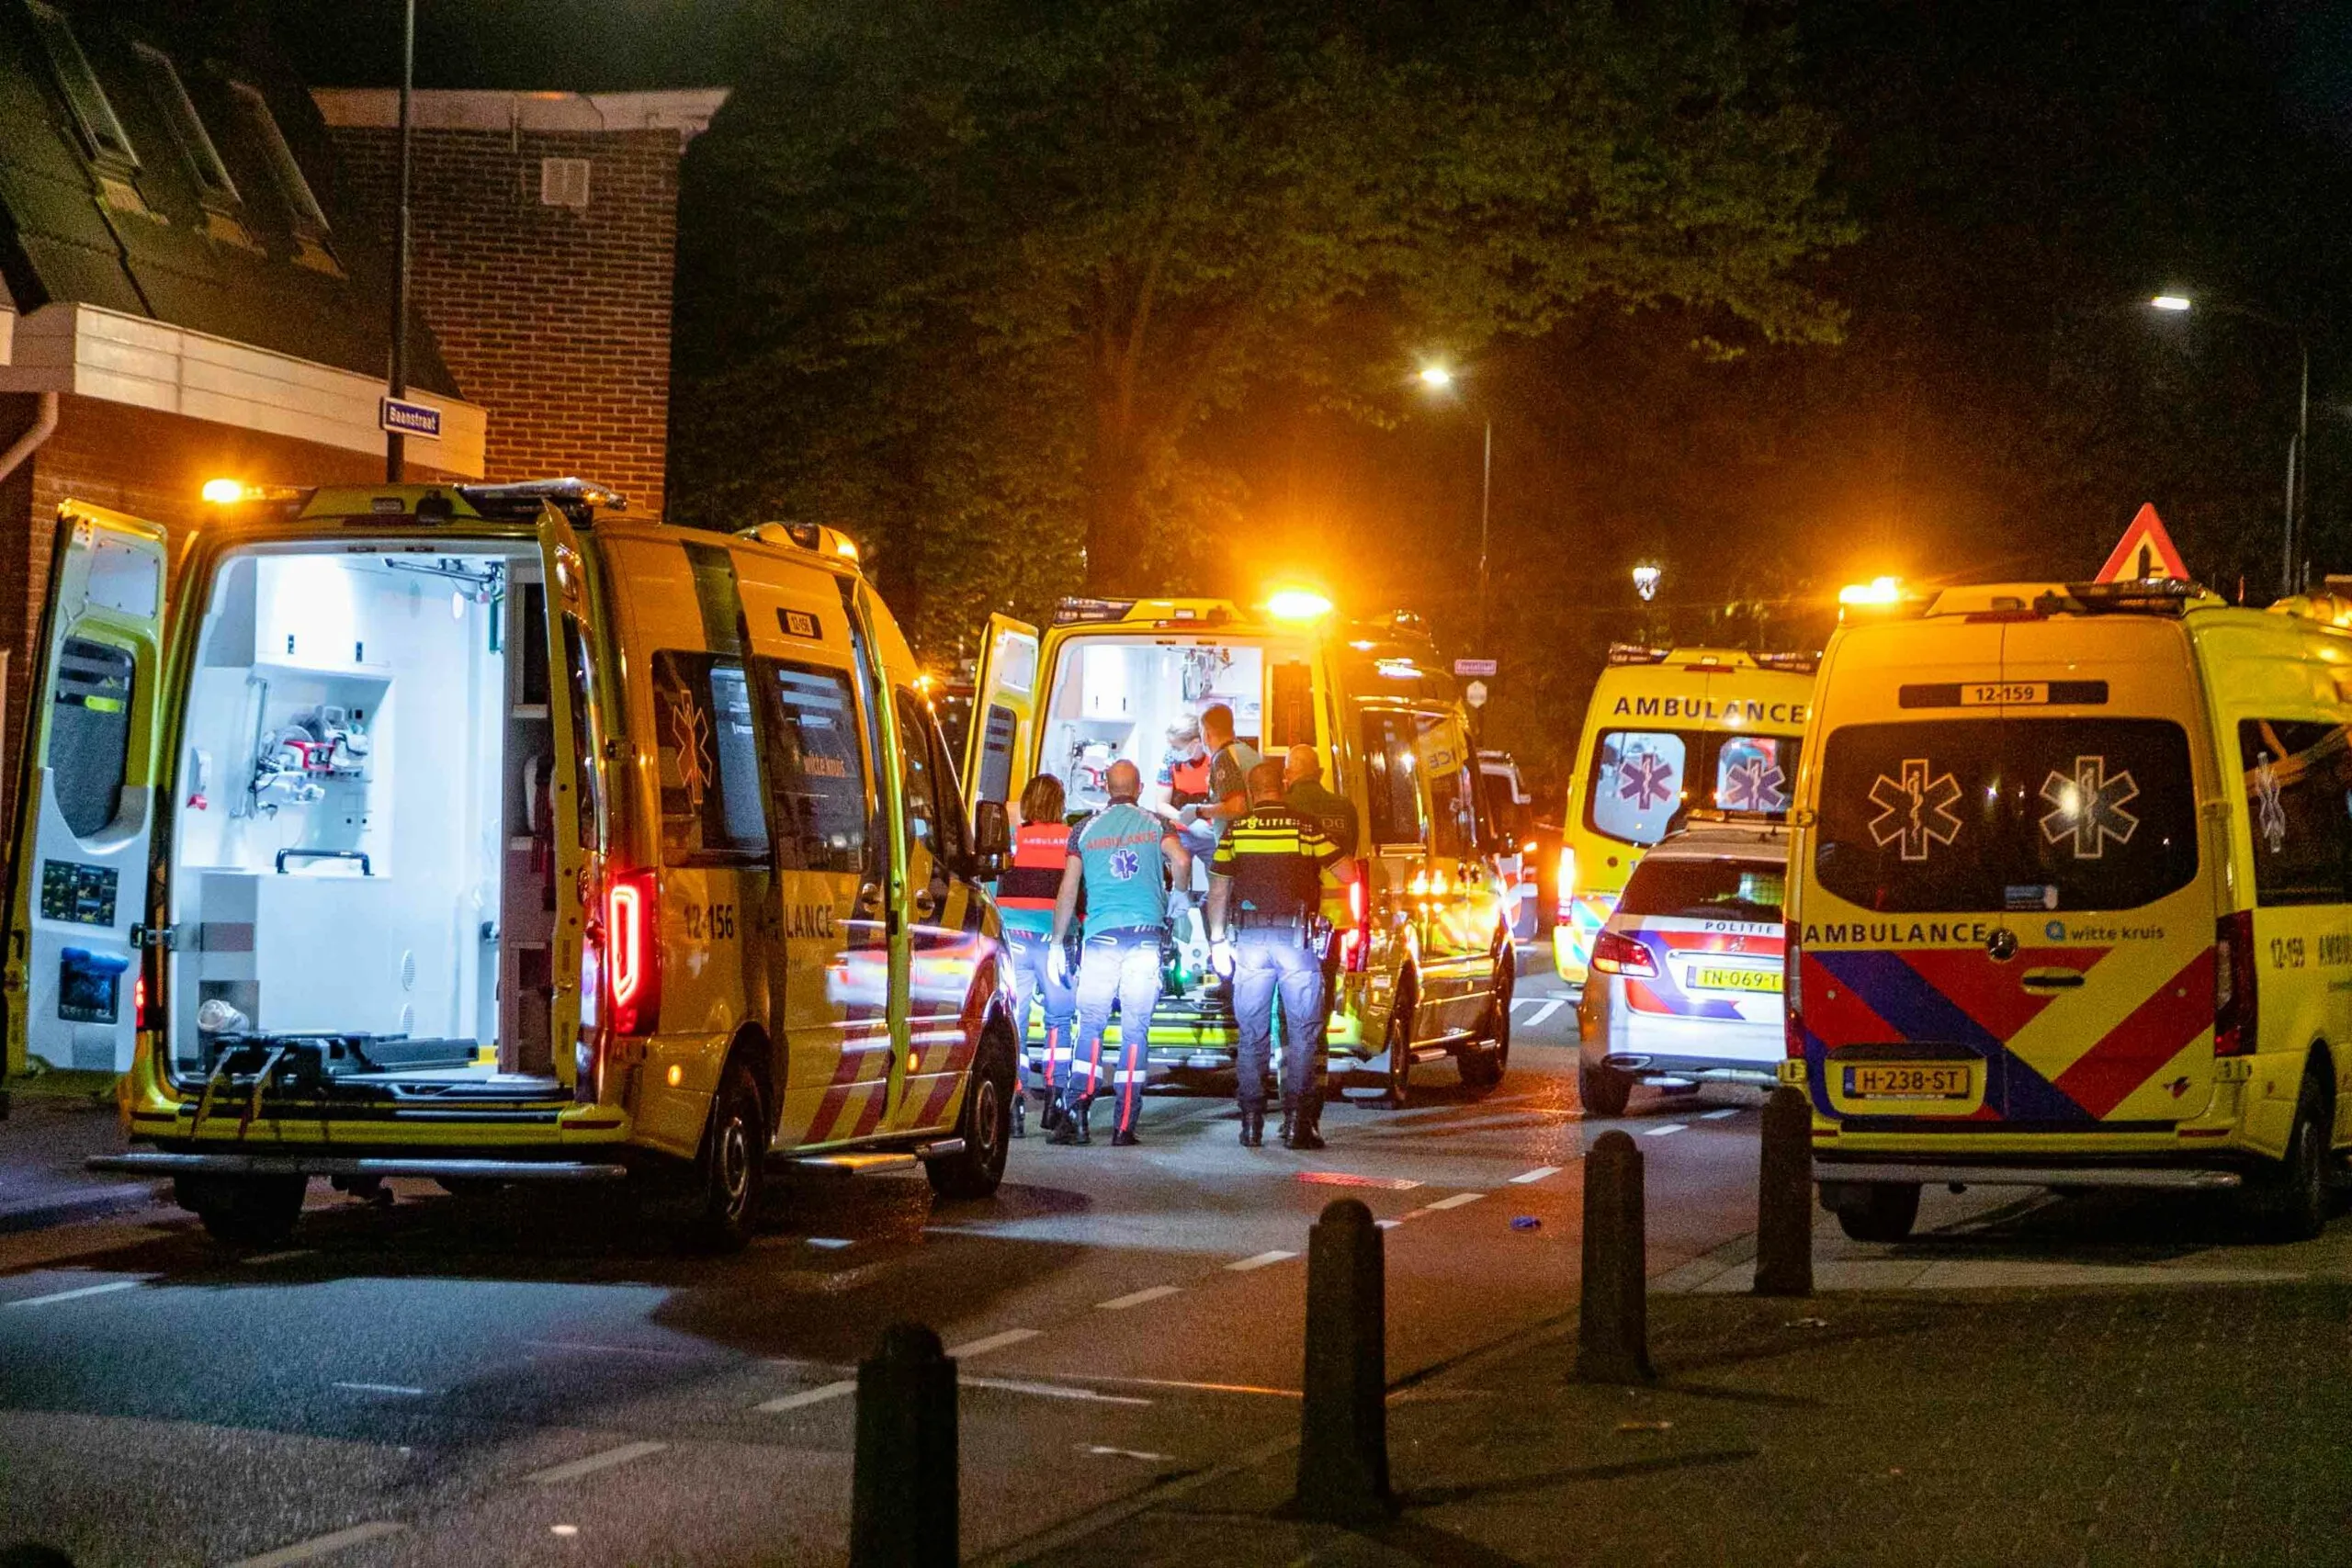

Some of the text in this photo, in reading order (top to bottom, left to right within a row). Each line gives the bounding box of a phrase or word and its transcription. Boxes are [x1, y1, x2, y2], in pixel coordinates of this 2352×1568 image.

[1975, 686, 2034, 701] 12-159
[1613, 696, 1804, 724] AMBULANCE
[1023, 837, 1069, 846] AMBULAN
[1086, 830, 1158, 851] AMBULANCE
[684, 904, 735, 940] 12-156
[1704, 921, 1774, 934] POLITIE
[1804, 923, 2165, 943] AMBULANCE witte kruis
[1702, 969, 1780, 987] TN-069-T
[1862, 1070, 1959, 1090] H-238-ST
